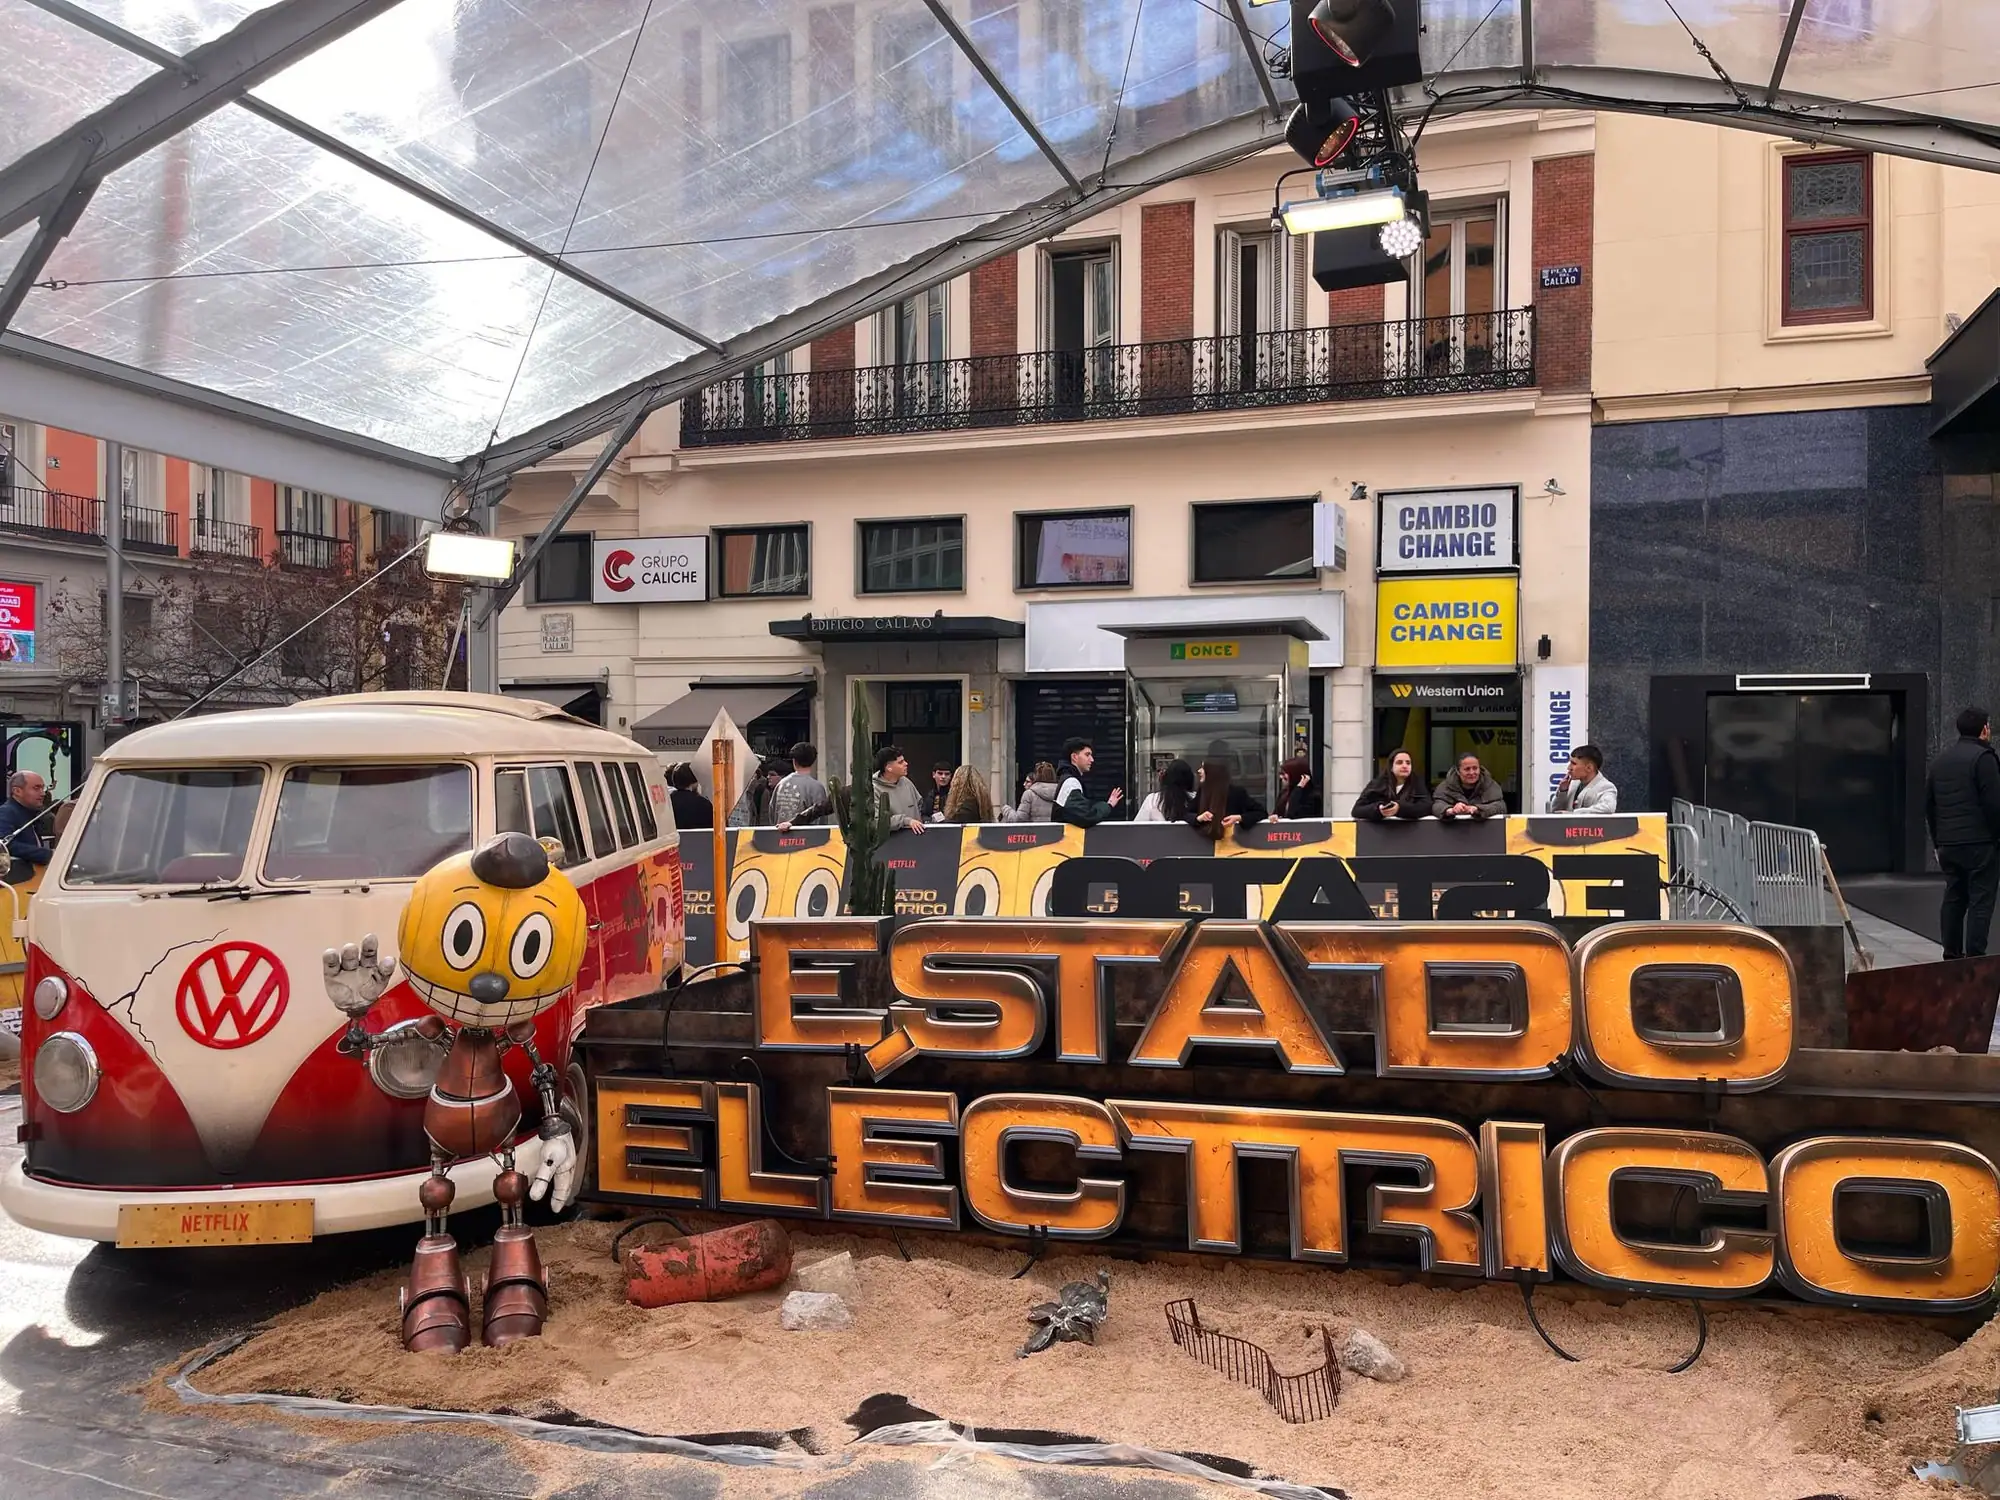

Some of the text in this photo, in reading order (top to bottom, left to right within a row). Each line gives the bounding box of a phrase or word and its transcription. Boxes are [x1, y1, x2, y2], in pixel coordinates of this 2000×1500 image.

[1550, 267, 1579, 275] PLAZA
[1544, 276, 1576, 286] CALLAO
[1399, 502, 1497, 531] CAMBIO
[1398, 531, 1496, 560] CHANGE
[641, 554, 689, 569] GRUPO
[641, 570, 698, 585] CALICHE
[1393, 601, 1500, 621] CAMBIO
[811, 618, 932, 631] EDIFICIO CALLAO
[1390, 623, 1503, 642] CHANGE
[1190, 644, 1233, 657] ONCE
[1415, 685, 1505, 697] Western Union
[1549, 691, 1571, 764] CHANGE
[1007, 834, 1037, 844] NETFLIX
[1267, 832, 1301, 842] NETFLIX
[1565, 827, 1604, 838] NETFLIX
[779, 838, 806, 847] NETFLIX
[888, 859, 917, 868] NETFLIX
[751, 916, 1796, 1093] ESTADO
[595, 1075, 2000, 1311] ELECTRICO
[181, 1212, 250, 1234] NETFLIX
